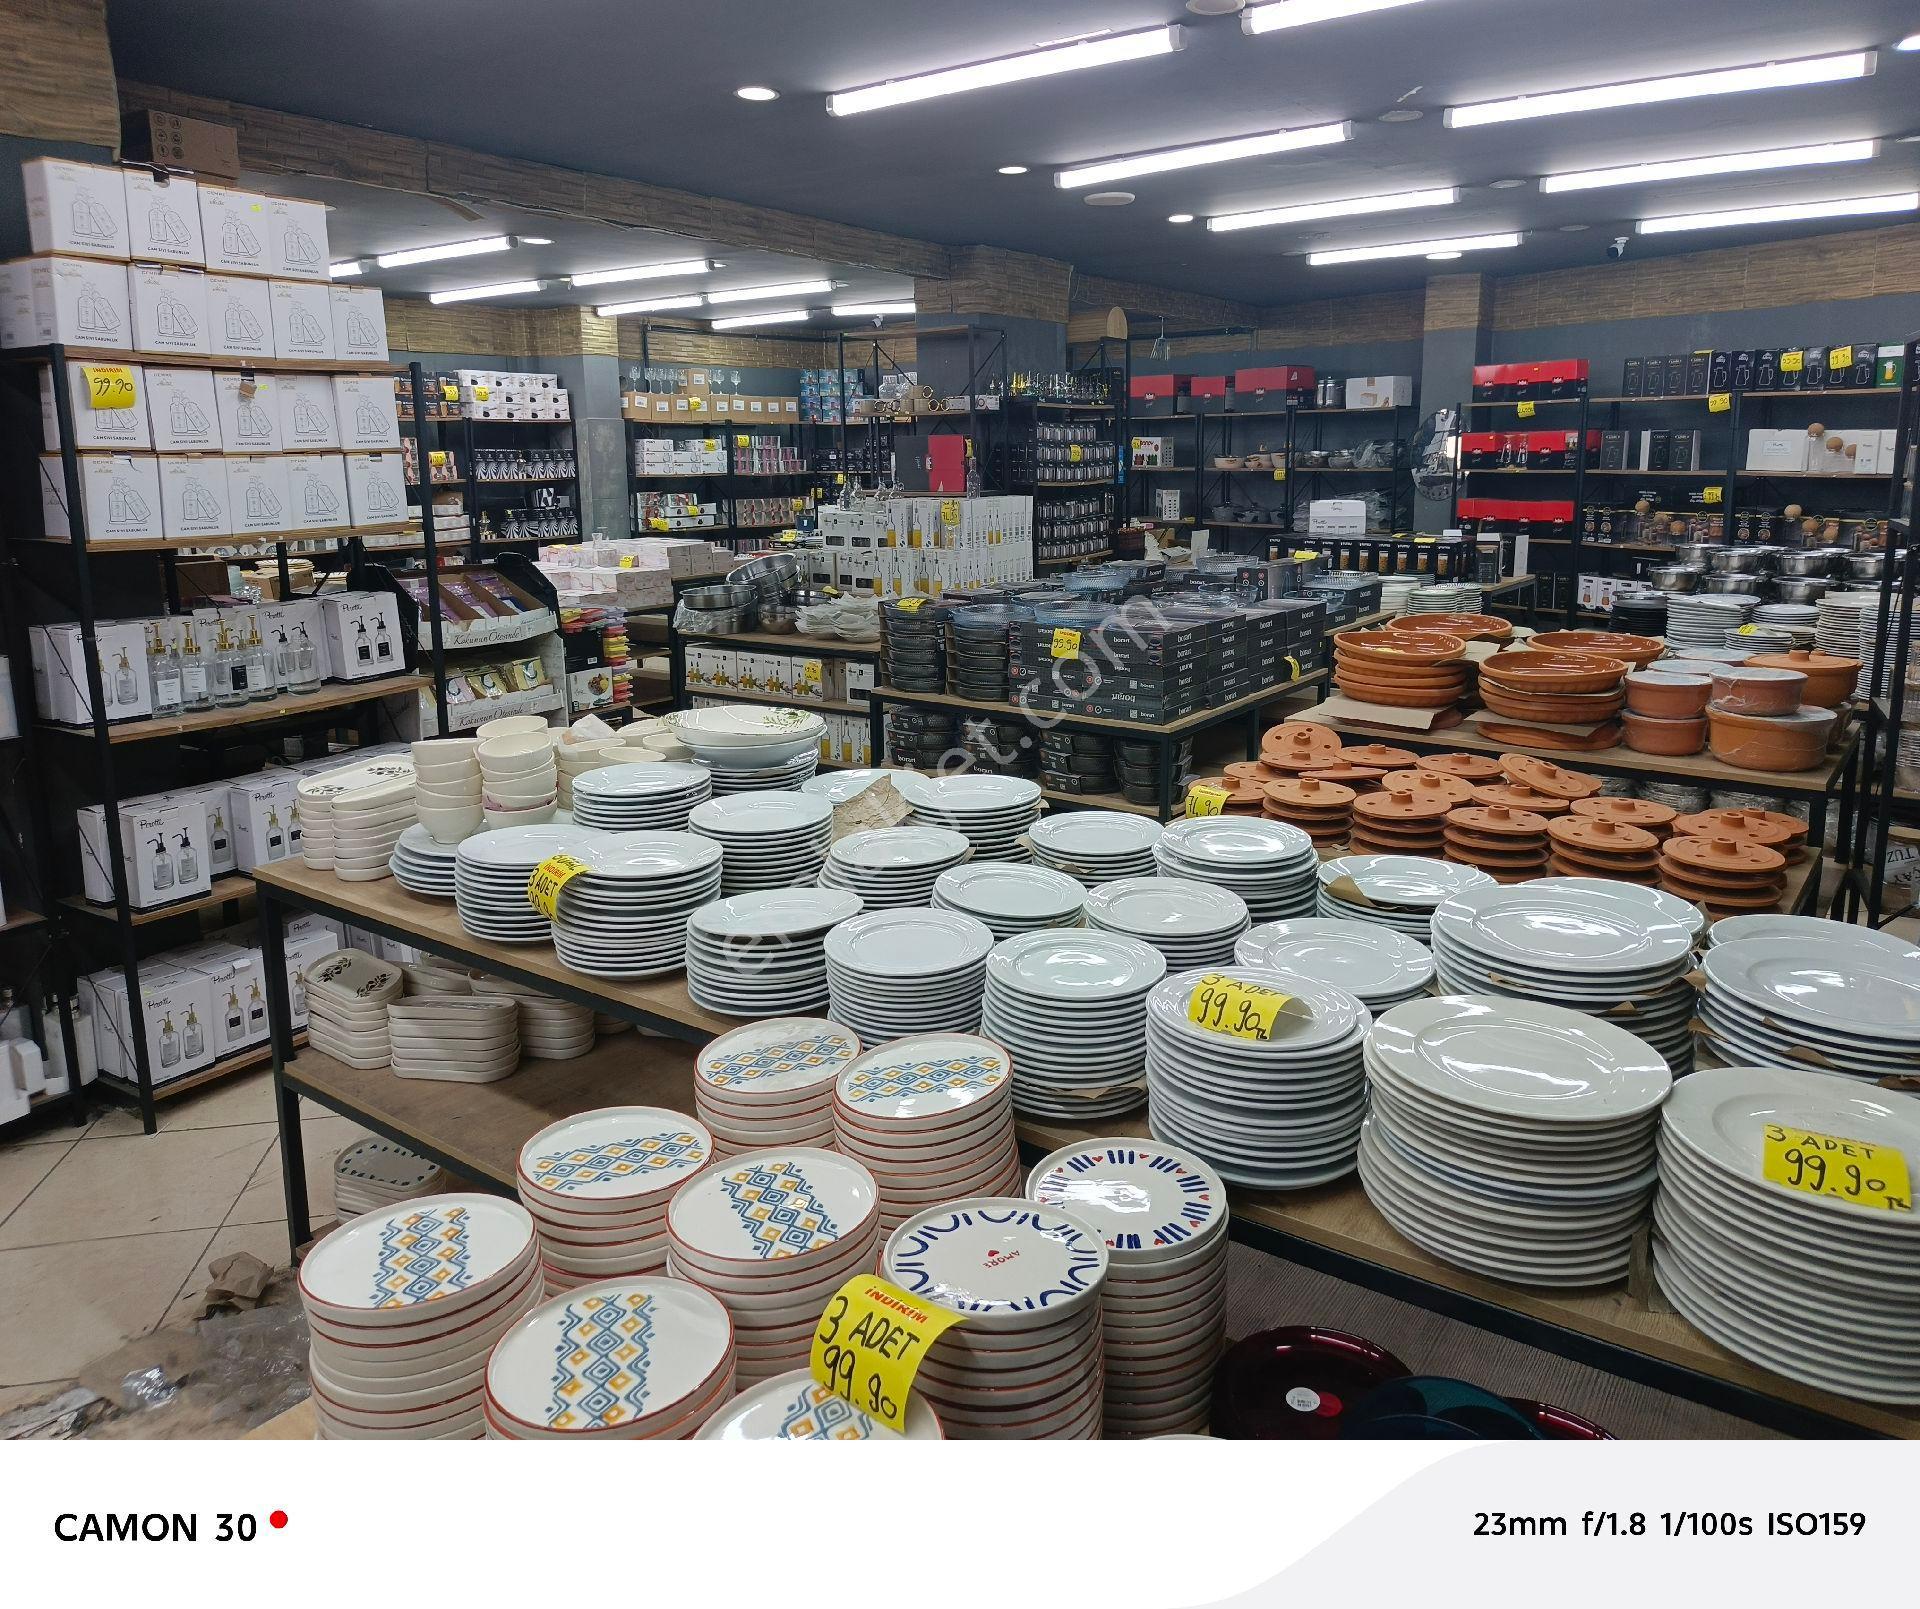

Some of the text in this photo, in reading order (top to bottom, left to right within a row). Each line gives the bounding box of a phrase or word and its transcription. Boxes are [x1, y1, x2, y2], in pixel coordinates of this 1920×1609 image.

[94, 378, 133, 396] 99.90
[528, 868, 558, 897] 3 ADET
[1201, 973, 1285, 995] 3 ADET
[1197, 988, 1260, 1032] 99.90
[1766, 1124, 1874, 1159] 3 ADET
[1784, 1148, 1886, 1196] 99.90
[982, 1250, 1020, 1270] AMORE
[864, 1286, 928, 1324] İNDİRİM
[820, 1296, 920, 1360] 3 ADET
